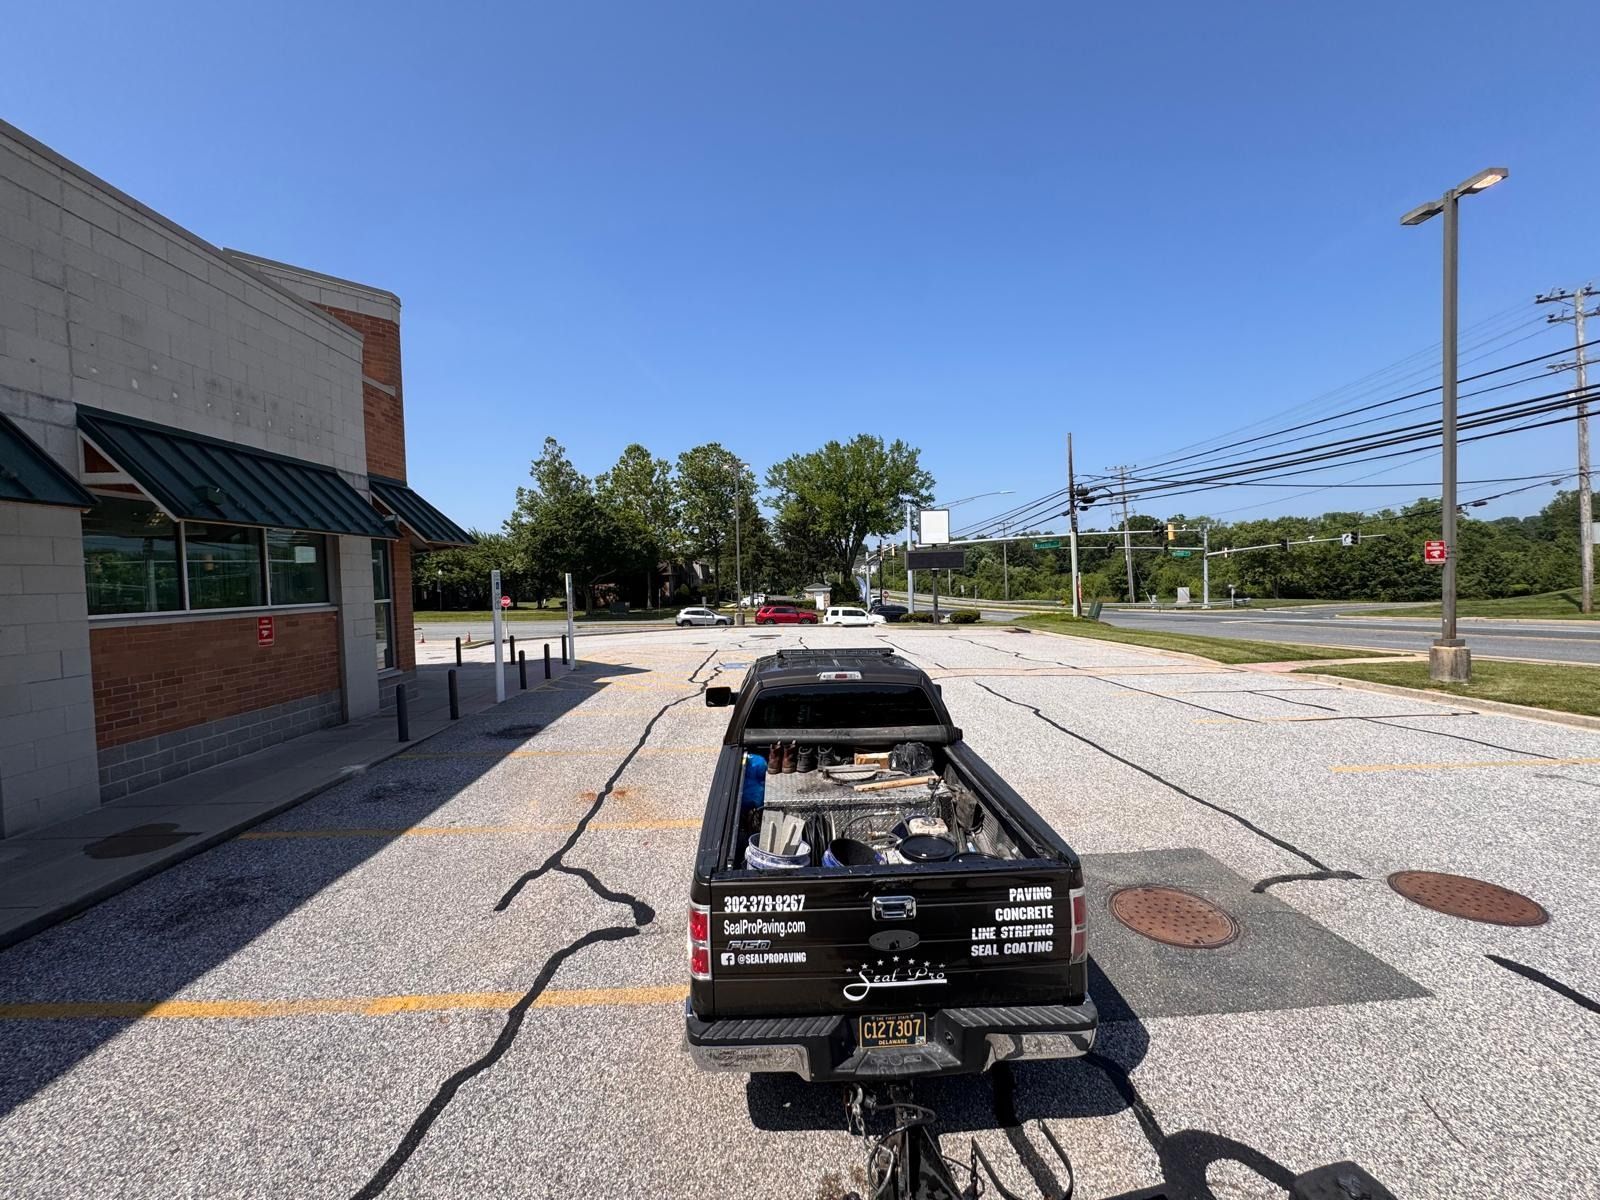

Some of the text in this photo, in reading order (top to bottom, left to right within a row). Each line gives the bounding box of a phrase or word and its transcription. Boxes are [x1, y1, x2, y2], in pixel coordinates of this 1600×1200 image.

[1009, 886, 1052, 902] PAVING
[724, 894, 806, 913] 302-379-8267
[995, 905, 1054, 922] CONCRETE
[723, 918, 806, 938] SealProPaving.com
[971, 923, 1054, 940] LINE STRIPING
[971, 940, 1054, 957] SEAL COATING
[737, 952, 807, 964] @SEALPROPAVING
[843, 967, 945, 1001] Seal Pro
[863, 1019, 921, 1039] C127307
